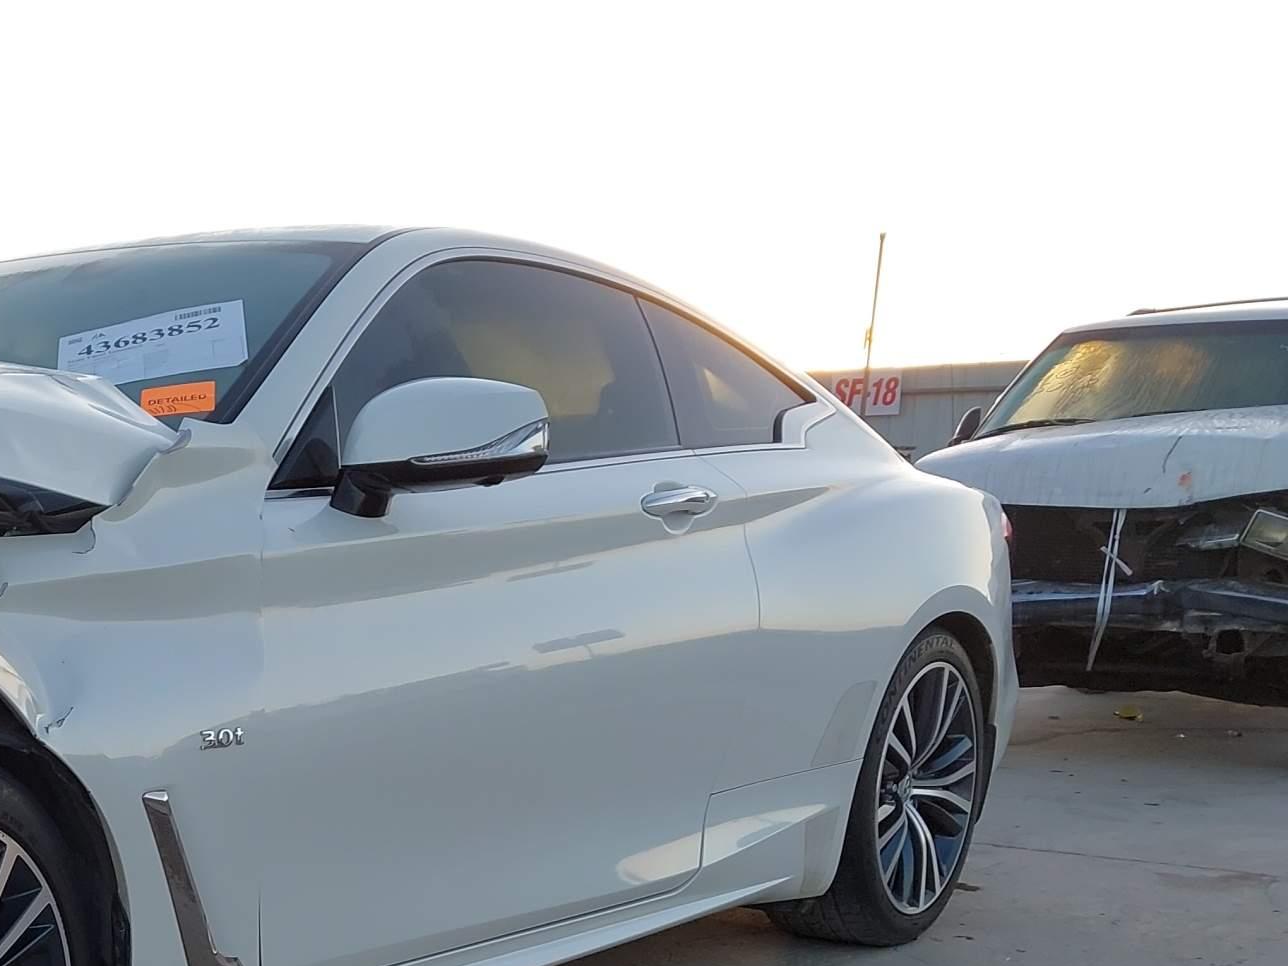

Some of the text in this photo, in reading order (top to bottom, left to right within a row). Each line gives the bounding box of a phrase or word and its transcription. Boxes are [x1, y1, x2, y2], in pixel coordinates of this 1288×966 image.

[78, 317, 220, 356] 43683852
[147, 393, 208, 406] DETAILED
[835, 376, 900, 407] SF-18
